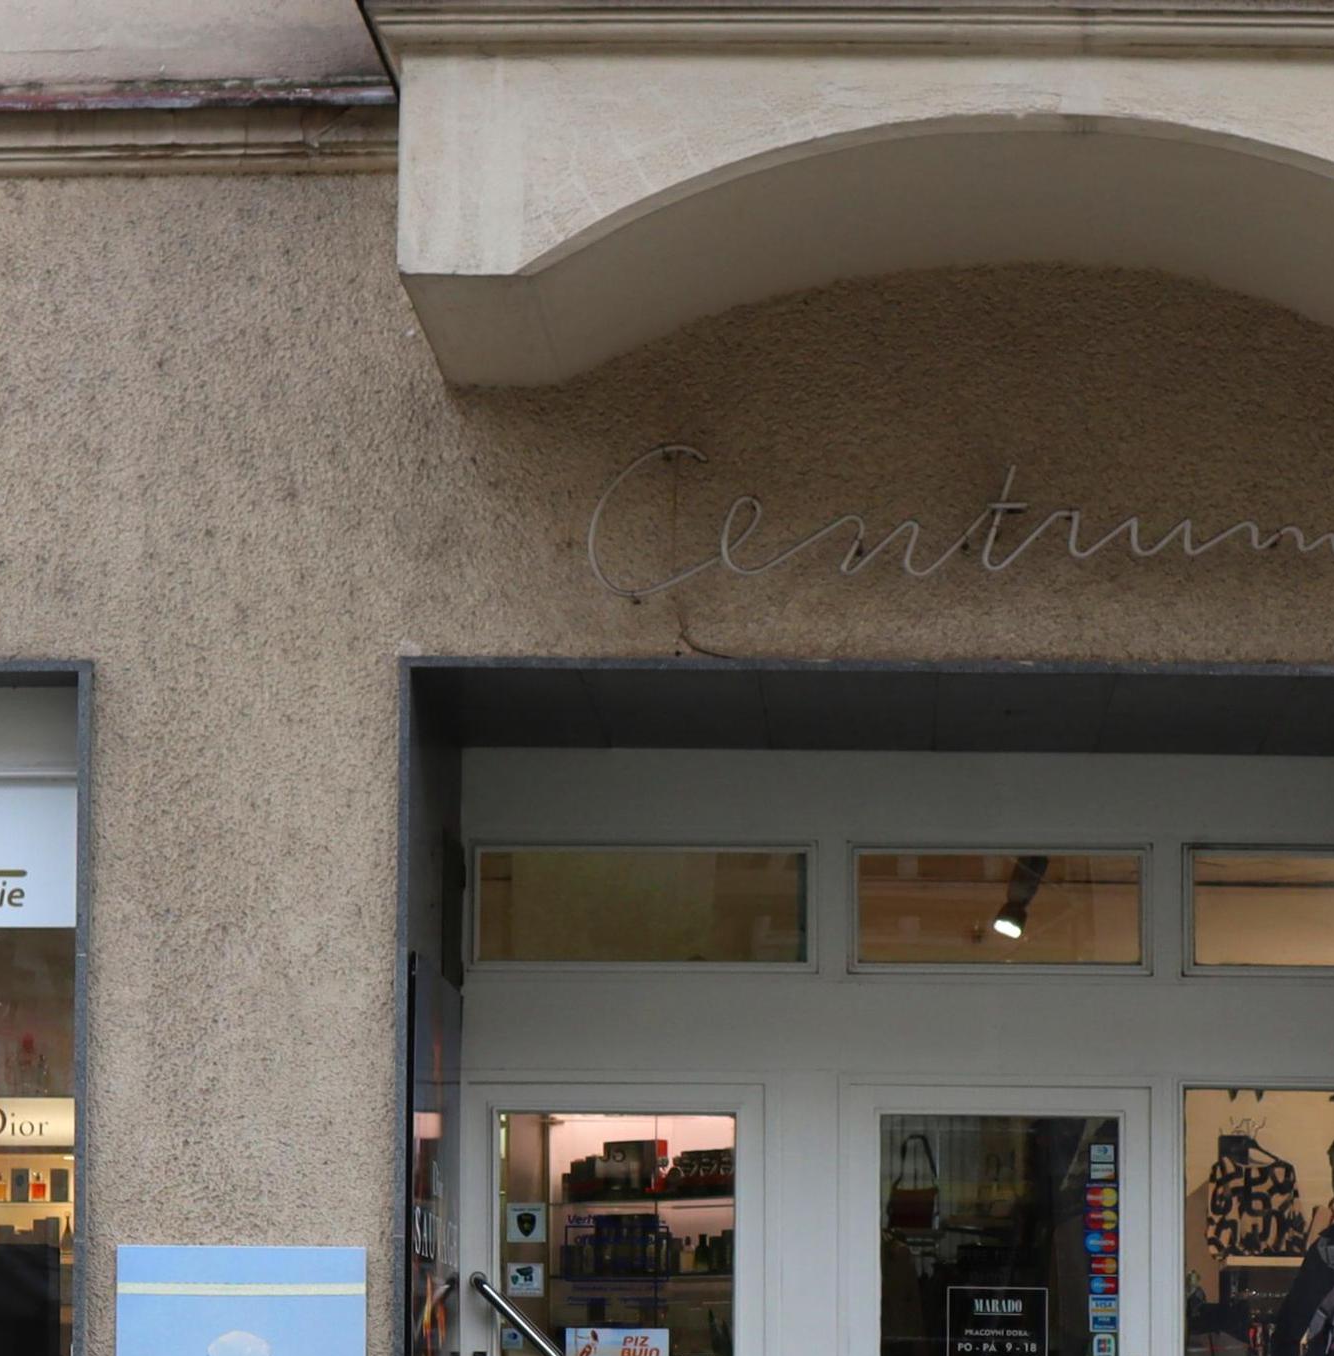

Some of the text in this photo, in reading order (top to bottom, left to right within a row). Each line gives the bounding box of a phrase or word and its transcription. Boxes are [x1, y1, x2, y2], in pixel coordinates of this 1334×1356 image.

[973, 1298, 1023, 1313] MARADO
[622, 1335, 651, 1347] PIZ
[957, 1342, 973, 1352] PO
[1005, 1342, 1013, 1352] 9
[1024, 1343, 1037, 1353] 18
